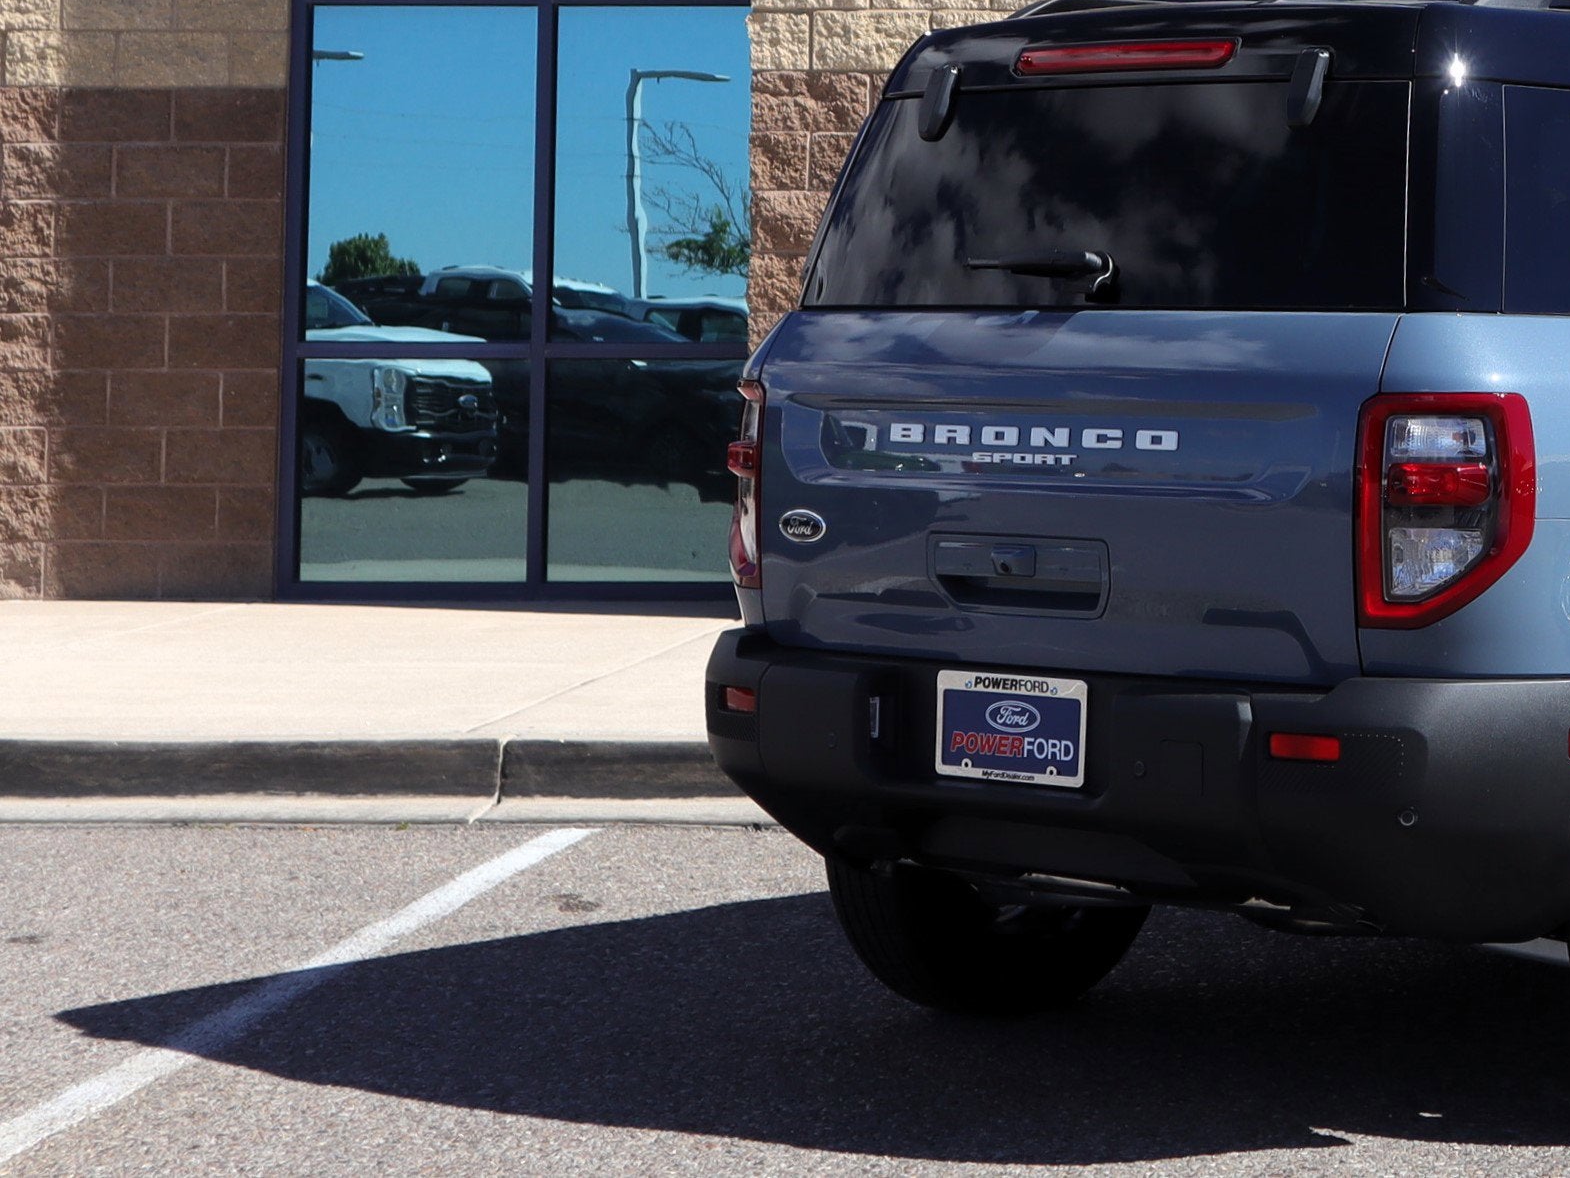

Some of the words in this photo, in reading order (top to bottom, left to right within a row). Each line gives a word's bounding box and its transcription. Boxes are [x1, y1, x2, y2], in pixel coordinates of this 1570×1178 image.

[888, 421, 1180, 452] BRONCO
[971, 451, 1077, 465] SPORT
[787, 515, 814, 536] Ford
[973, 675, 1049, 694] POWERFORD
[996, 705, 1030, 727] Ford
[950, 730, 1074, 762] POWERFORD
